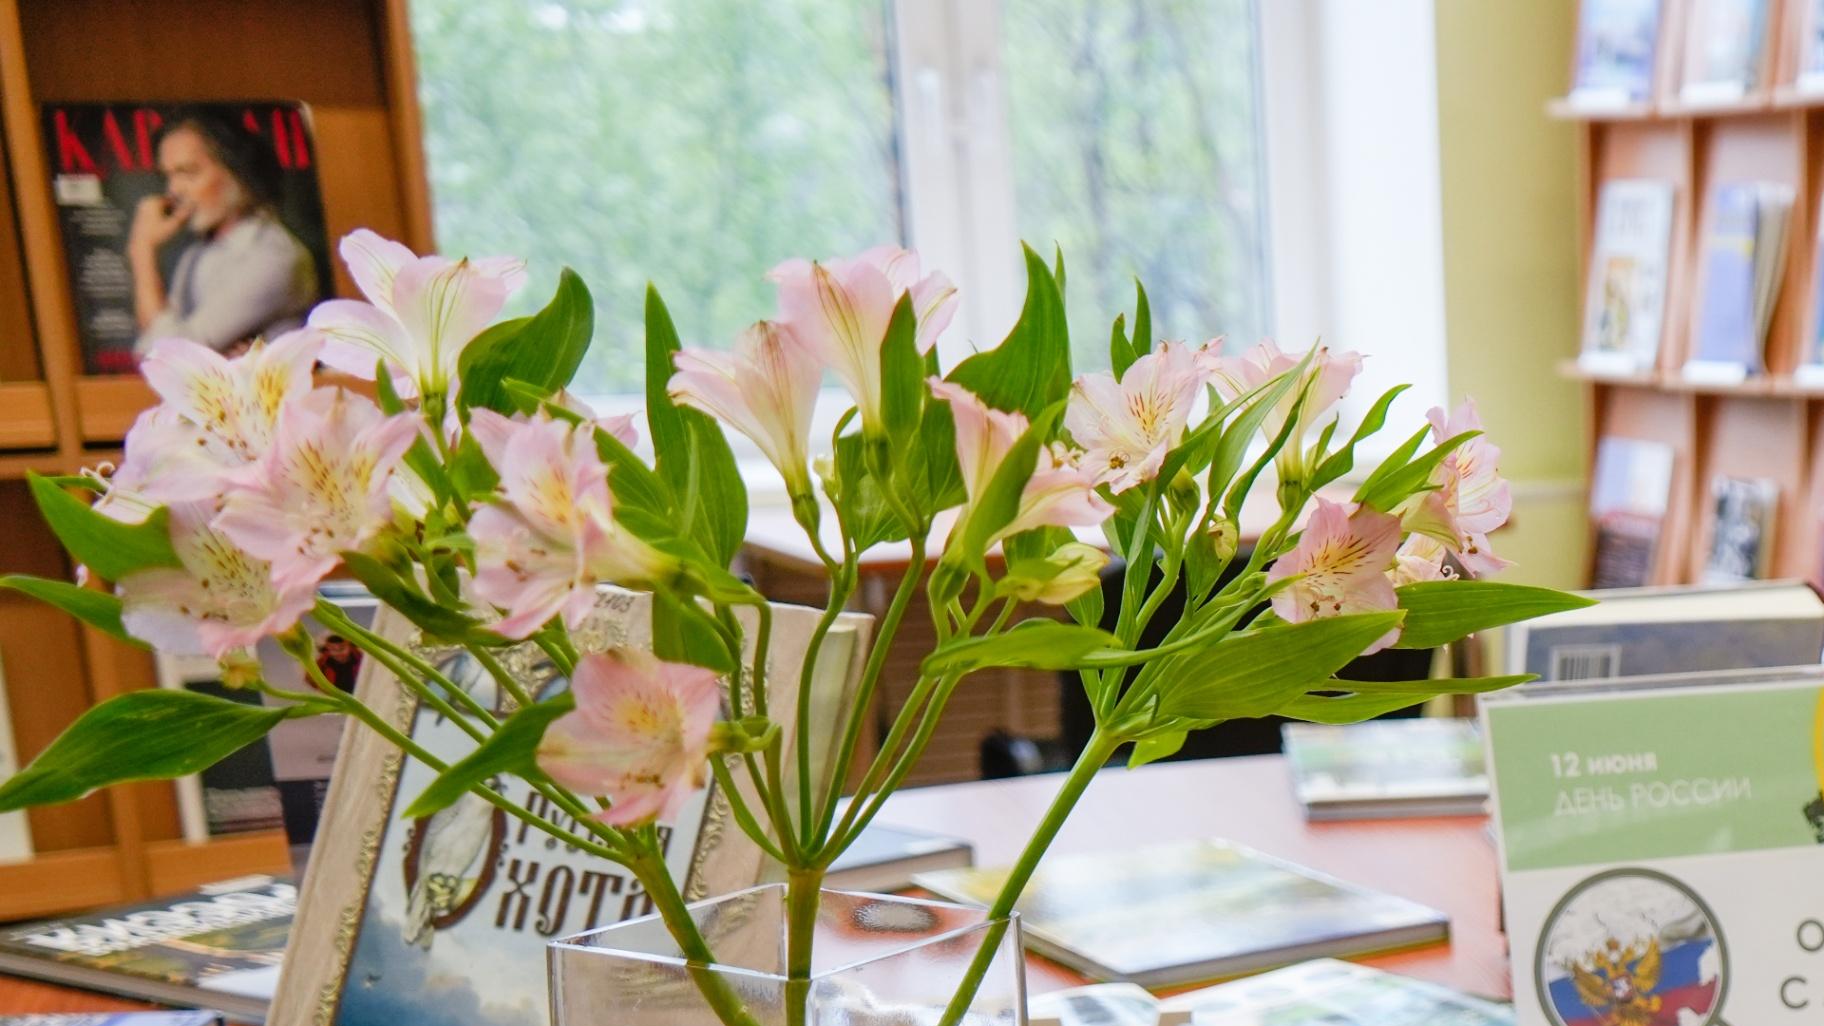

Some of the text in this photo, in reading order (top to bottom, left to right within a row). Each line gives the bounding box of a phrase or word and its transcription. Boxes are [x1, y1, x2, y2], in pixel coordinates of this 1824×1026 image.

[1549, 751, 1658, 778] 12 июня
[1553, 776, 1752, 819] ДЕНЬ РОССИИ
[1779, 975, 1810, 1011] С
